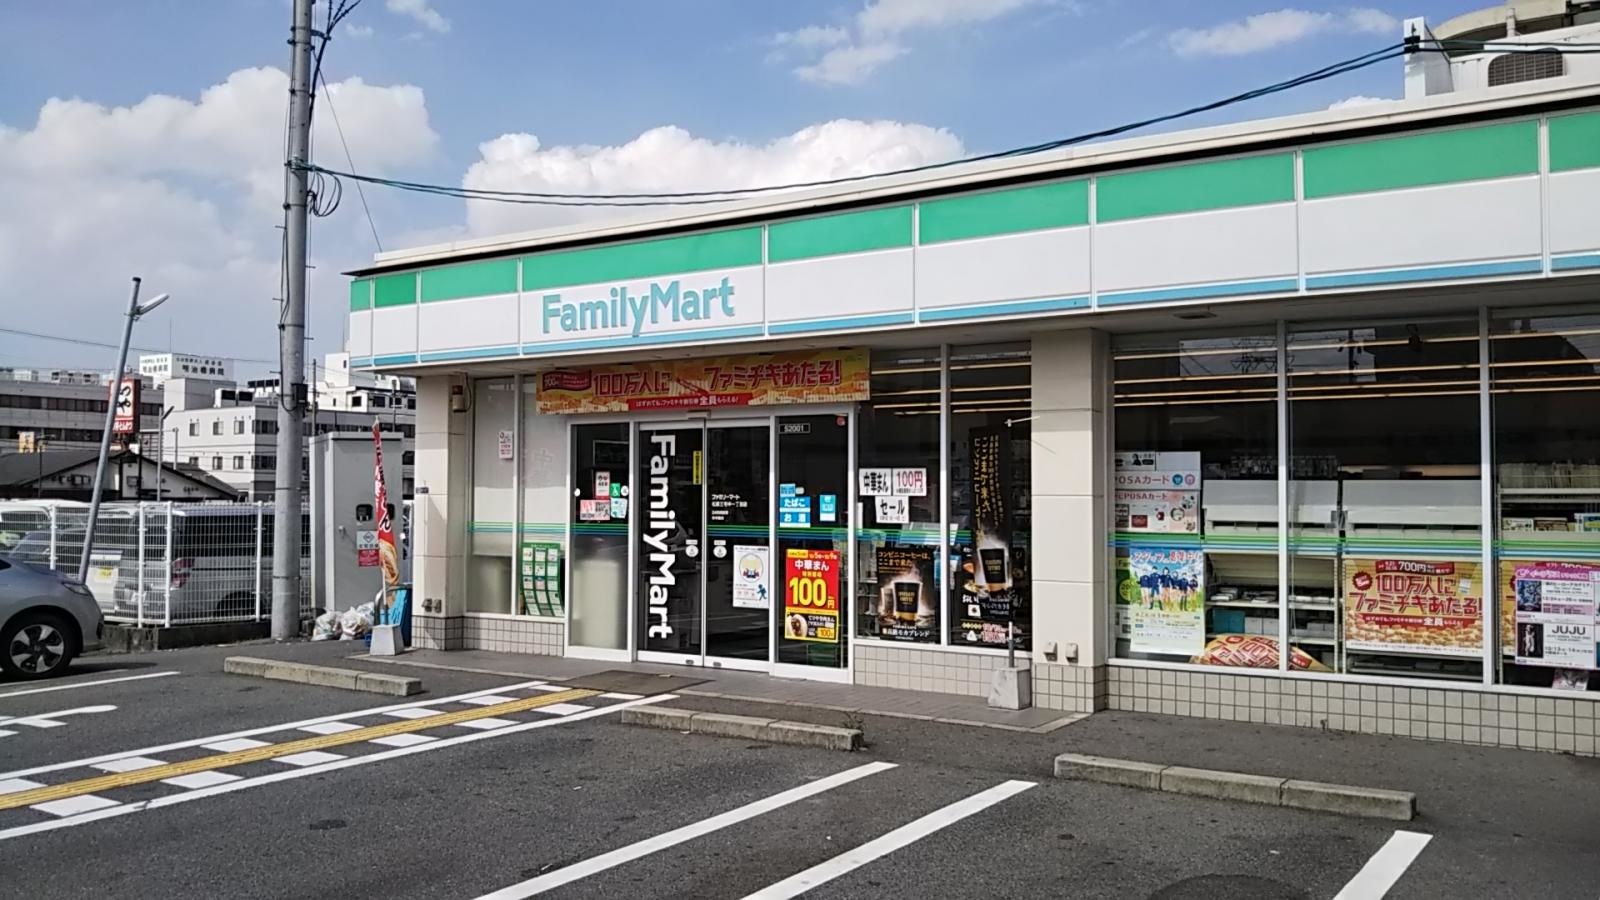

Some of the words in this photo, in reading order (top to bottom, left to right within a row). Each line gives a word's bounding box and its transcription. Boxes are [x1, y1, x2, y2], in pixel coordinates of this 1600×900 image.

[542, 276, 735, 338] FamilyMart
[594, 369, 672, 395] 100万人に
[864, 472, 889, 493] 中華まん
[896, 471, 923, 488] 100円
[1115, 475, 1170, 485] OSAカード
[784, 499, 806, 507] たばこ
[880, 499, 905, 516] セール
[643, 434, 676, 639] FamilyMart
[794, 560, 830, 571] 中華まん
[1398, 561, 1426, 572] 700円
[1376, 574, 1456, 596] 100万人に
[1348, 592, 1483, 616] ファミチキあたる!
[1552, 625, 1586, 636] JUJU
